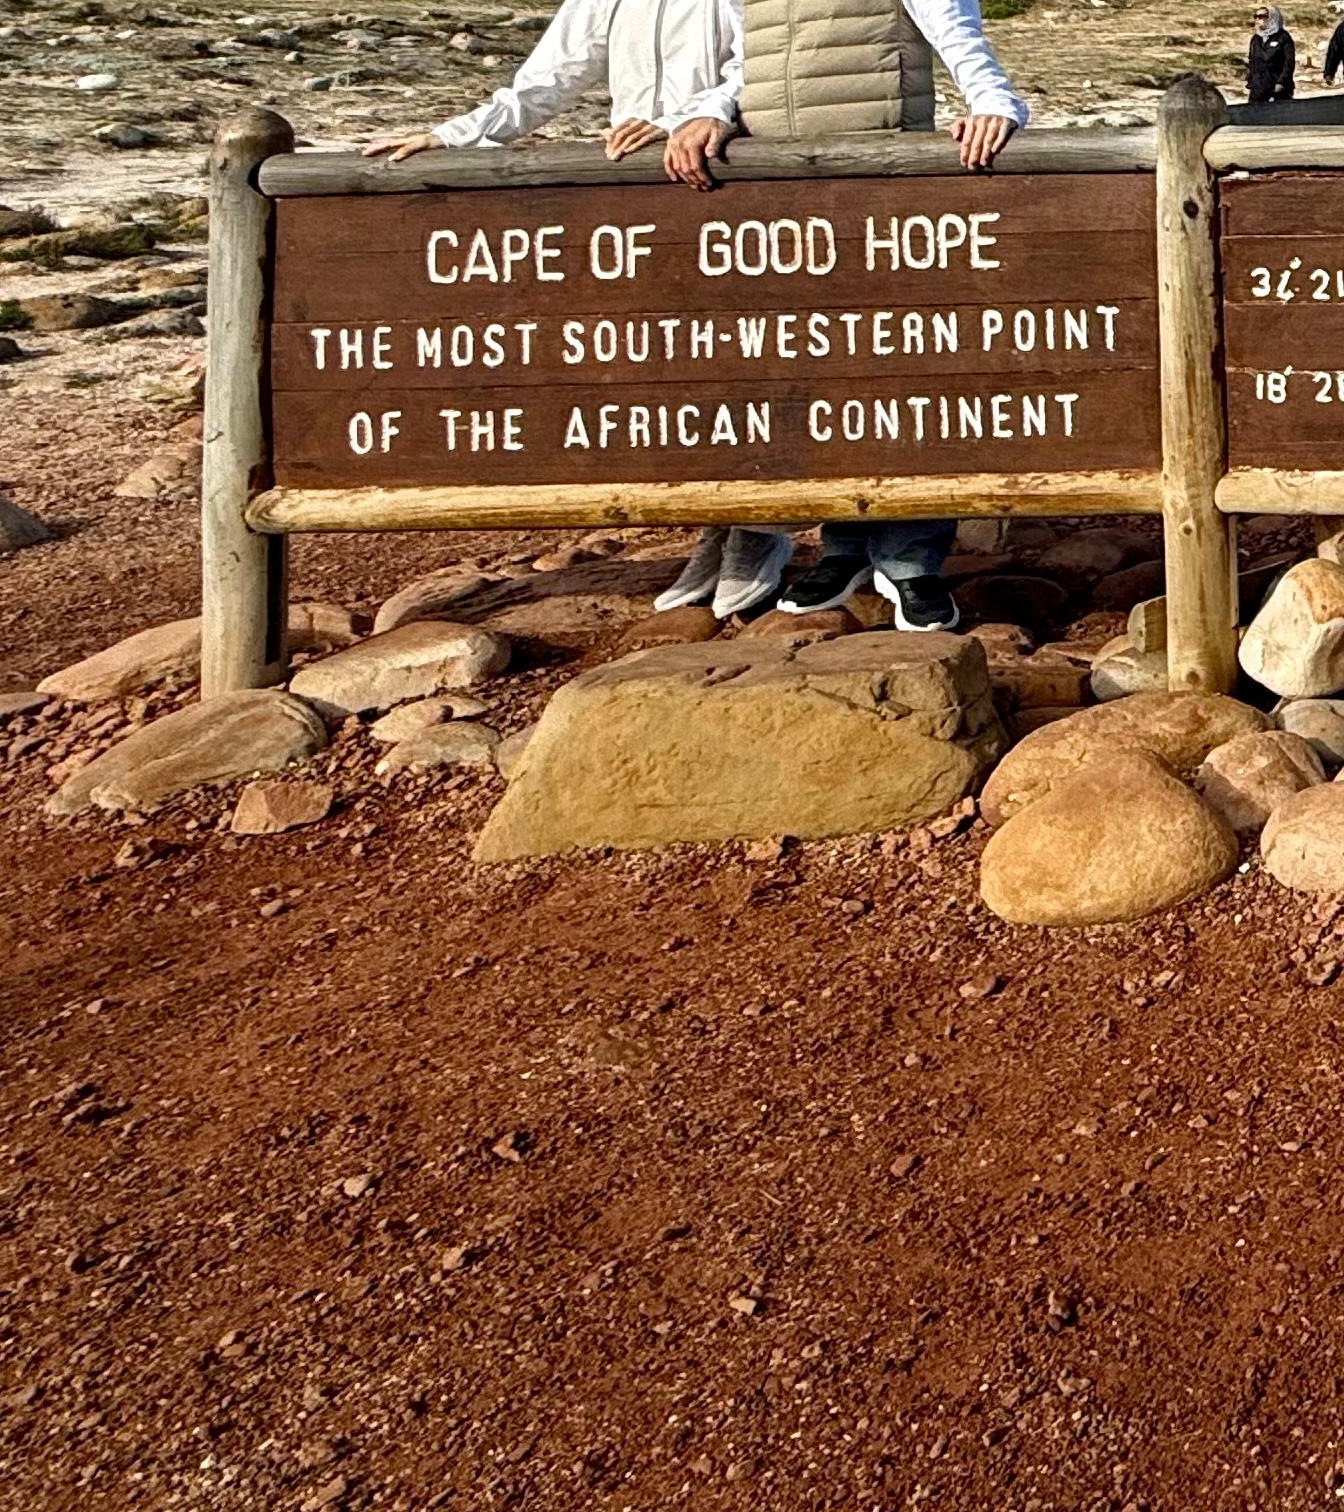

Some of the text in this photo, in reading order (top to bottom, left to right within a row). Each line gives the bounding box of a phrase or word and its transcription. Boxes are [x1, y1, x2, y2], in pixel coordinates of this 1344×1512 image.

[426, 212, 1001, 284] CAPE OF GOOD HOPE
[310, 305, 1120, 370] THE MOST SOUTH-WESTERN POINT
[348, 393, 1080, 455] OF THE AFRICAN CONTINENT
